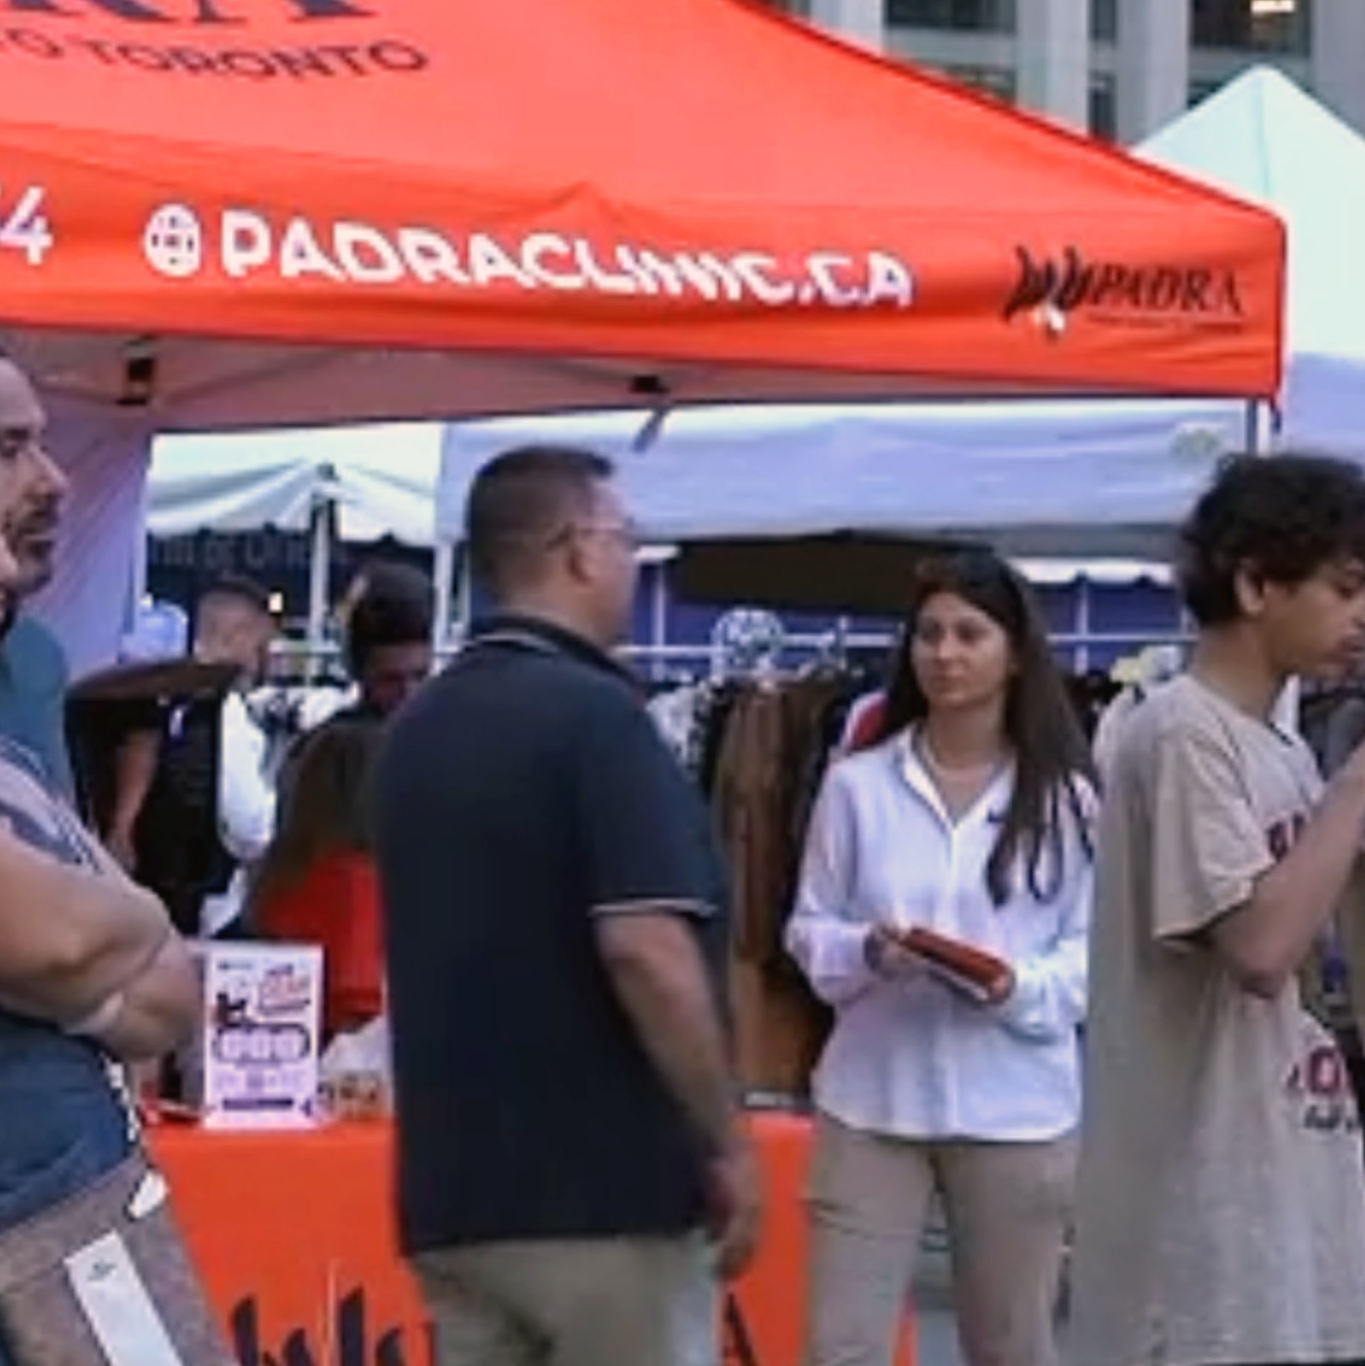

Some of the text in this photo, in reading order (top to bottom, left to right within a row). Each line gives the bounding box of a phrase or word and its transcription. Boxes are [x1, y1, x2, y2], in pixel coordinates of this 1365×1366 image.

[77, 37, 430, 79] TORONTO
[220, 208, 914, 309] PADRACLINIC.CA
[1086, 263, 1245, 317] PADRA
